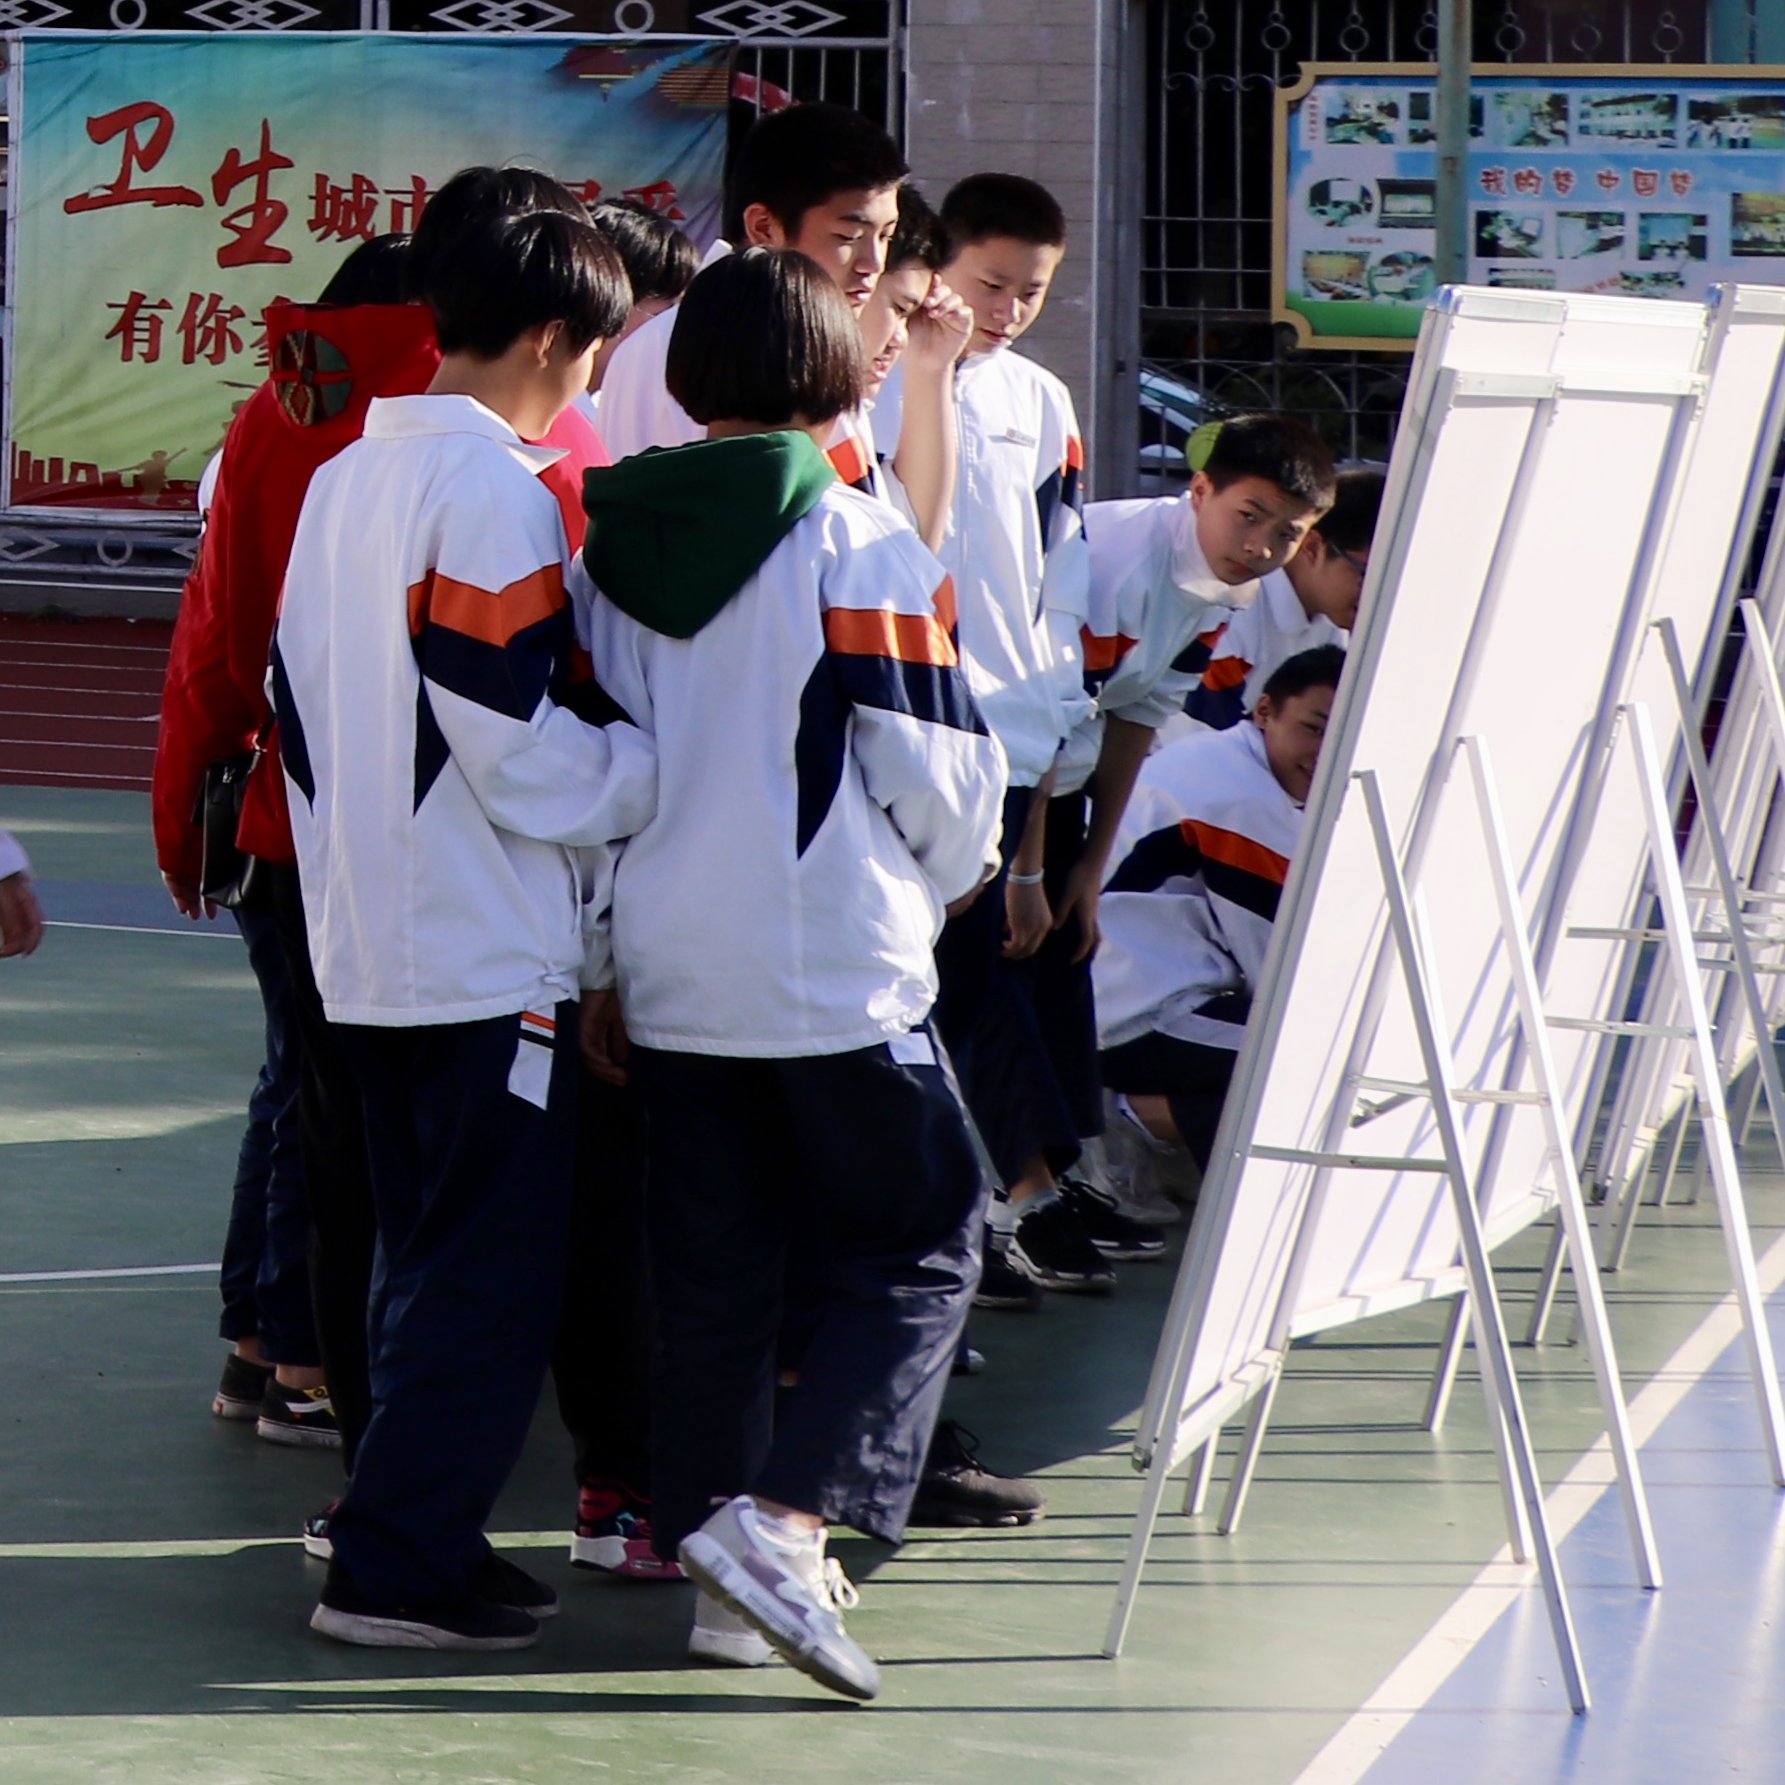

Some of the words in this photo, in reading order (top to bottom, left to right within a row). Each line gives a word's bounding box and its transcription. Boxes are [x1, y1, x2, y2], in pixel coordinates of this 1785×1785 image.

[1480, 166, 1578, 197] 我的梦
[1596, 167, 1696, 198] 中国梦
